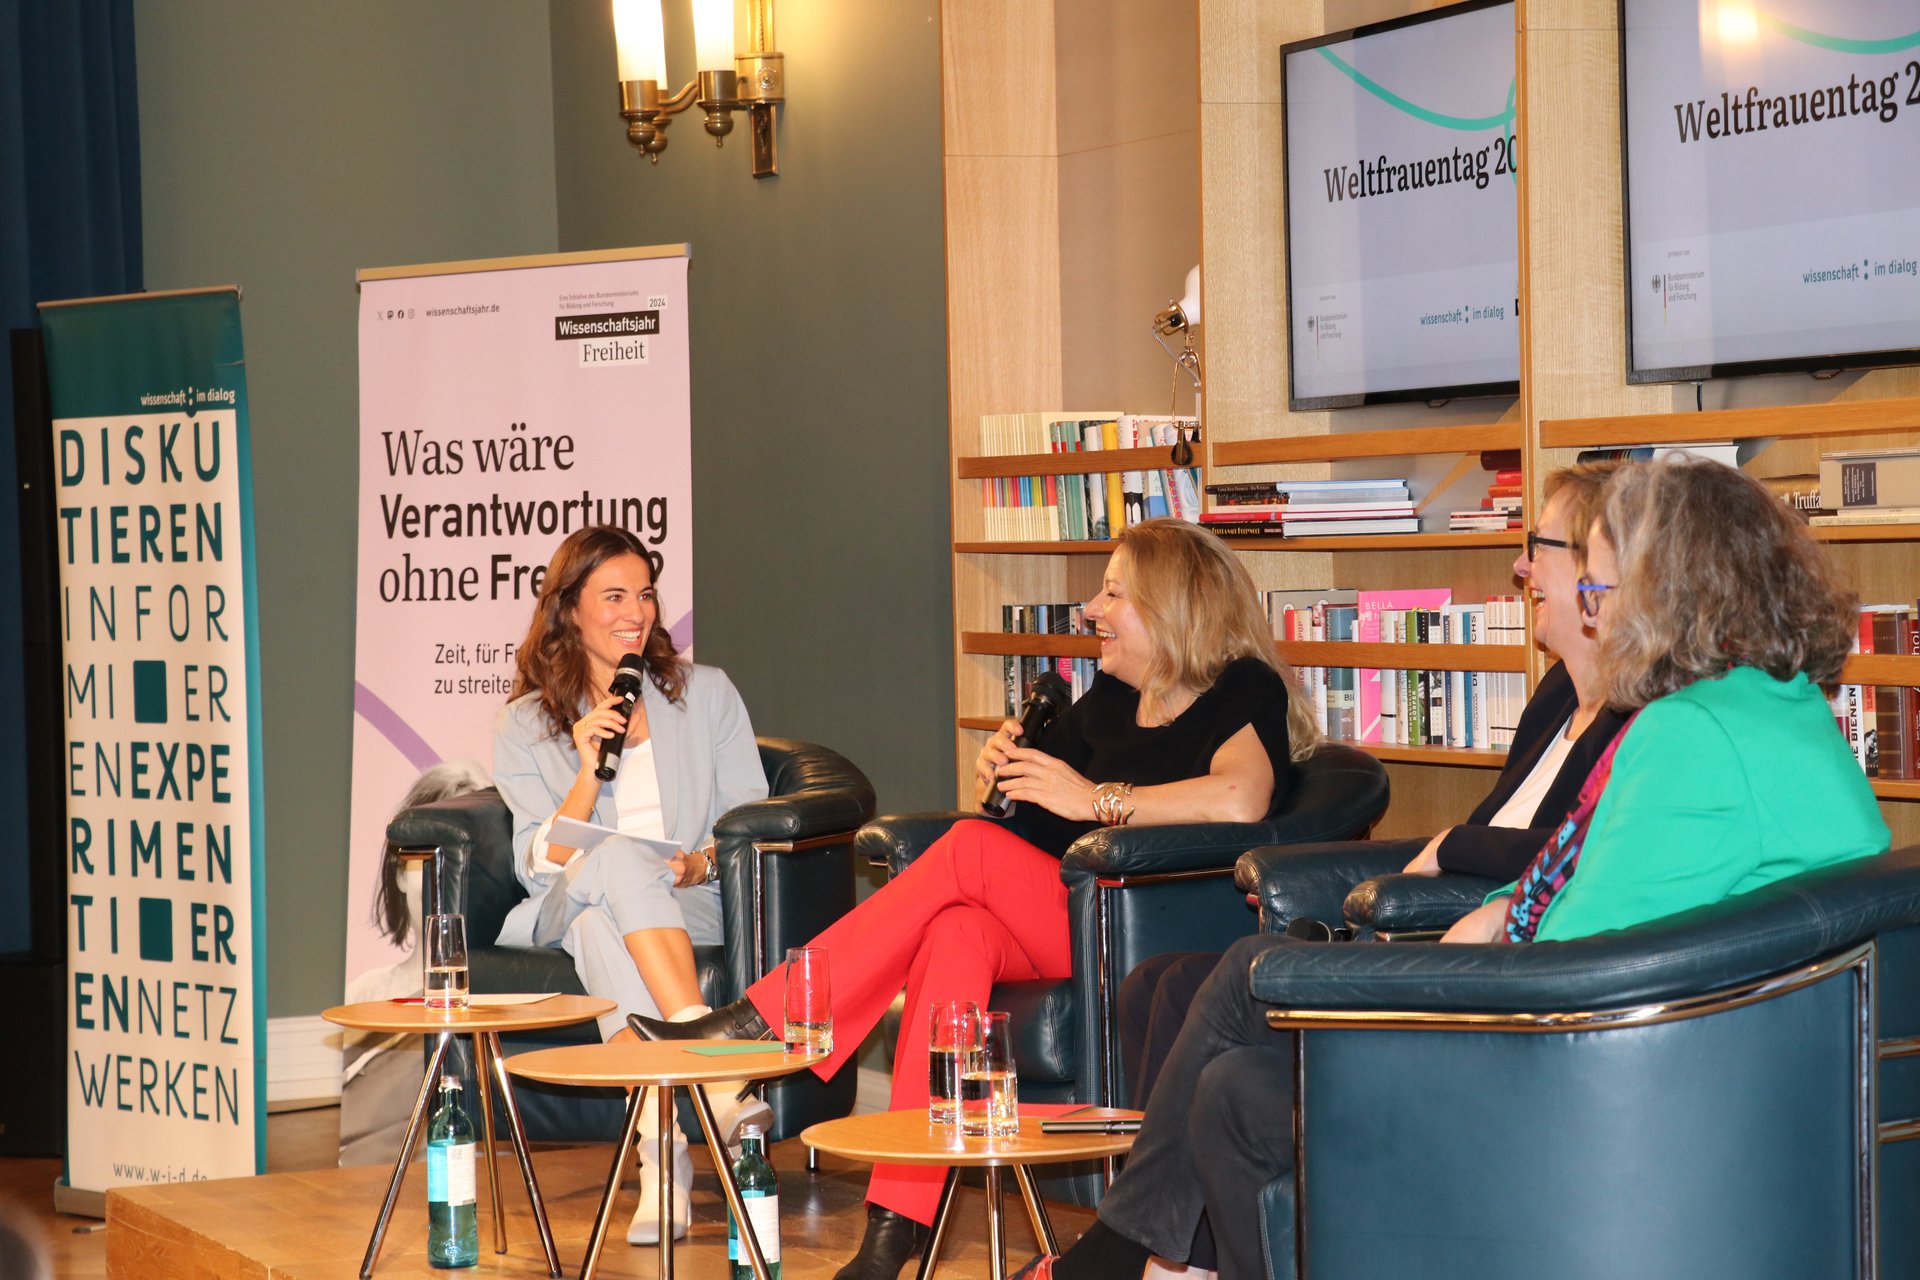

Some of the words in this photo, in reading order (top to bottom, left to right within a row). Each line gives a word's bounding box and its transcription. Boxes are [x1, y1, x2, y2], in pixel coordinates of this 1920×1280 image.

[1674, 71, 1899, 144] Weltfrauentag
[1324, 146, 1490, 203] Weltfrauentag
[1494, 135, 1517, 176] 20
[1803, 263, 1860, 284] wissenschaft
[1874, 261, 1886, 276] im
[1888, 258, 1917, 277] dialog
[425, 304, 500, 317] wissenschaftsjahr.de
[559, 315, 656, 336] Wissenschaftsjahr
[649, 298, 666, 308] 2024
[1420, 308, 1463, 326] wissenschaft
[1472, 307, 1482, 320] im
[1483, 305, 1505, 321] dialog
[583, 340, 646, 362] Freiheit
[140, 389, 186, 406] wissenschaft
[196, 389, 206, 402] im
[207, 387, 235, 405] dialog
[60, 421, 220, 487] DISKU
[381, 429, 464, 477] Was
[472, 422, 575, 473] wäre
[60, 502, 223, 565] TIEREN
[380, 490, 668, 545] Verantwortung
[379, 553, 480, 603] ohne
[65, 584, 229, 642] INFOR
[1365, 601, 1393, 610] BELLA
[435, 643, 470, 667] Zeit,
[476, 643, 500, 664] für
[434, 679, 453, 694] zu
[1849, 687, 1859, 742] BIENEN
[70, 817, 232, 884] RIMEN
[74, 1049, 239, 1125] WERKEN
